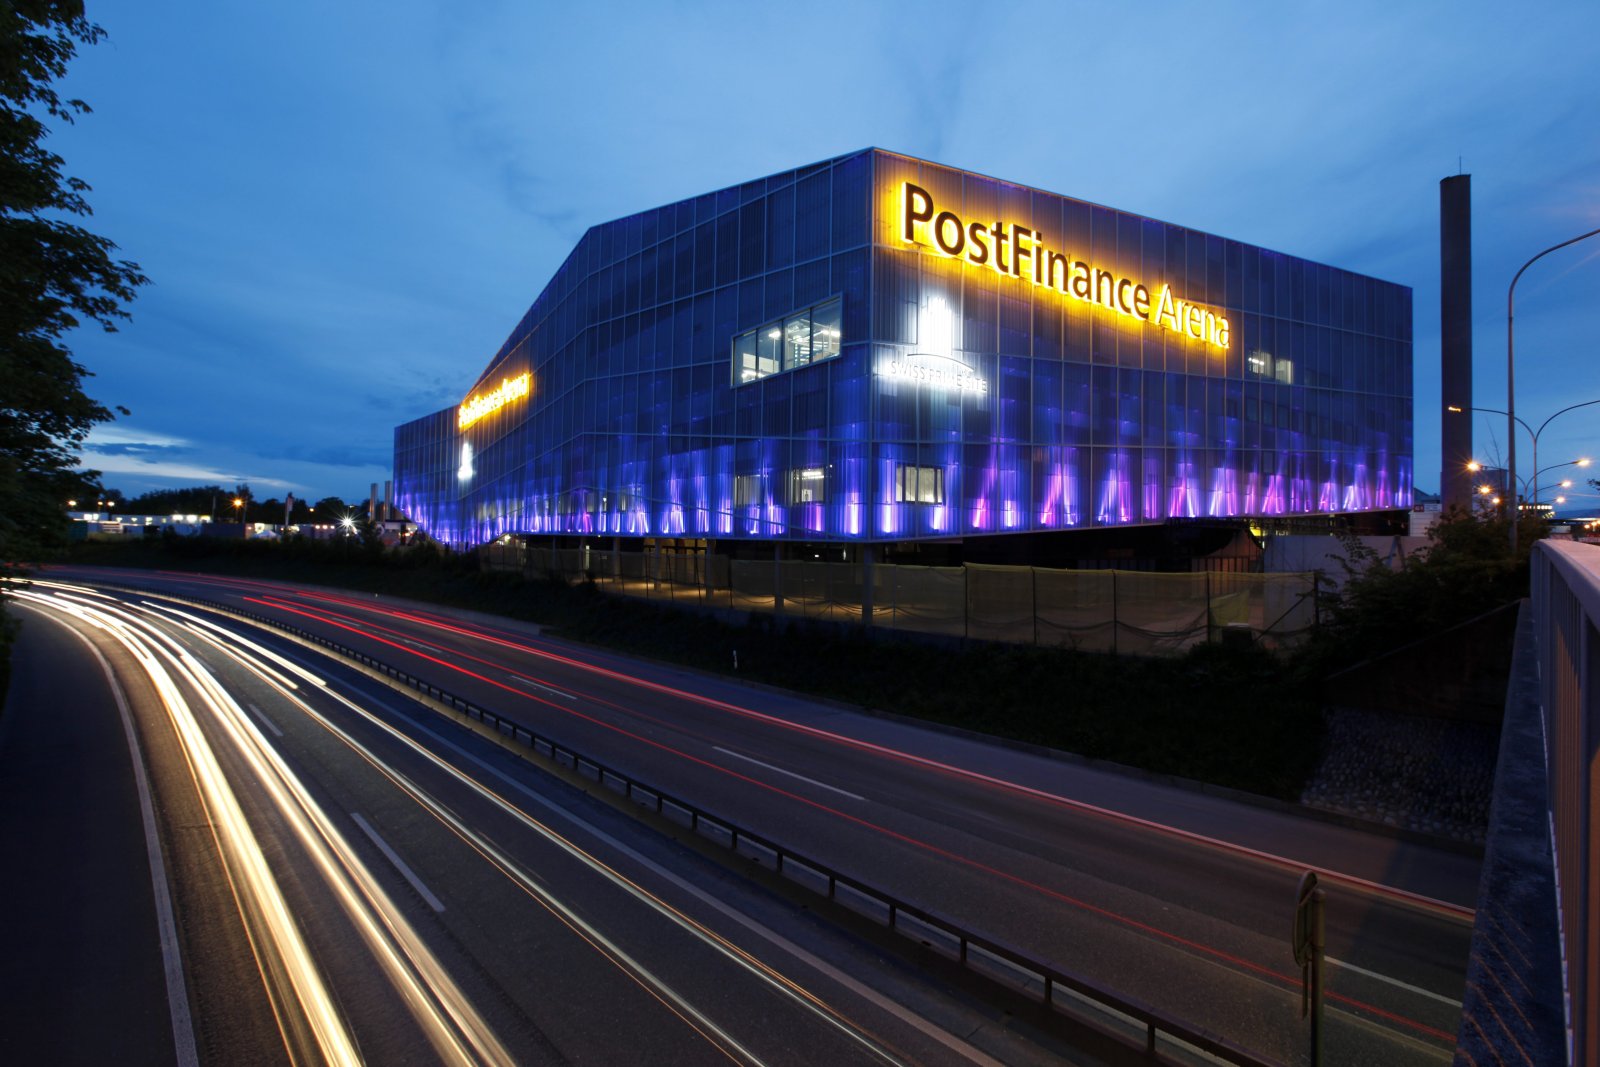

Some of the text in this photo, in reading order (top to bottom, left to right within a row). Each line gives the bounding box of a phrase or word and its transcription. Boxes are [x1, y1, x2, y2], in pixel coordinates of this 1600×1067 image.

[902, 181, 1230, 348] PostFinance Arena
[891, 360, 925, 380] SWISS
